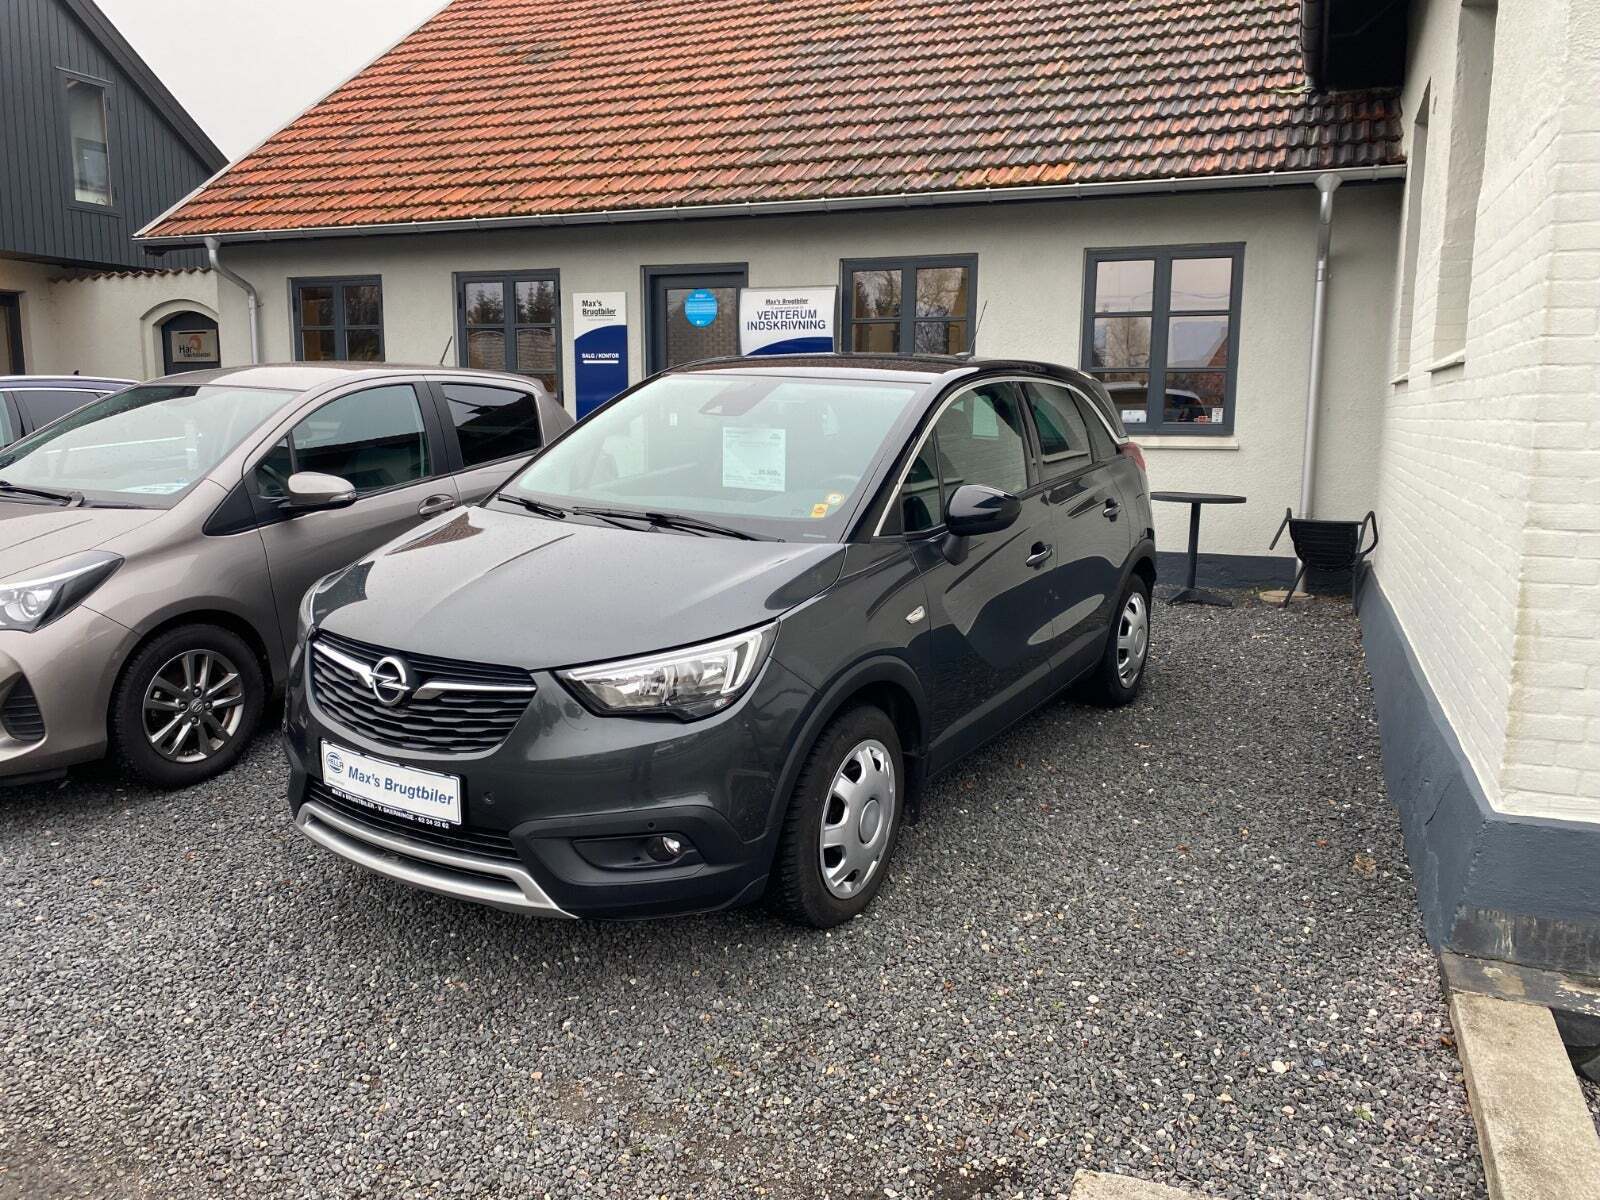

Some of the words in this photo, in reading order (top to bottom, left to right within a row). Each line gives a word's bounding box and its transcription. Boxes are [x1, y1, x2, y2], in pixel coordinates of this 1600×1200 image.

[582, 299, 602, 307] Max's
[782, 297, 809, 305] Brugtbiler
[582, 307, 616, 317] Brugtbiler
[757, 309, 817, 320] VENTERUM
[747, 320, 826, 330] INDSKRIVNING
[348, 765, 381, 788] Max's
[384, 777, 454, 806] Brugtbiler
